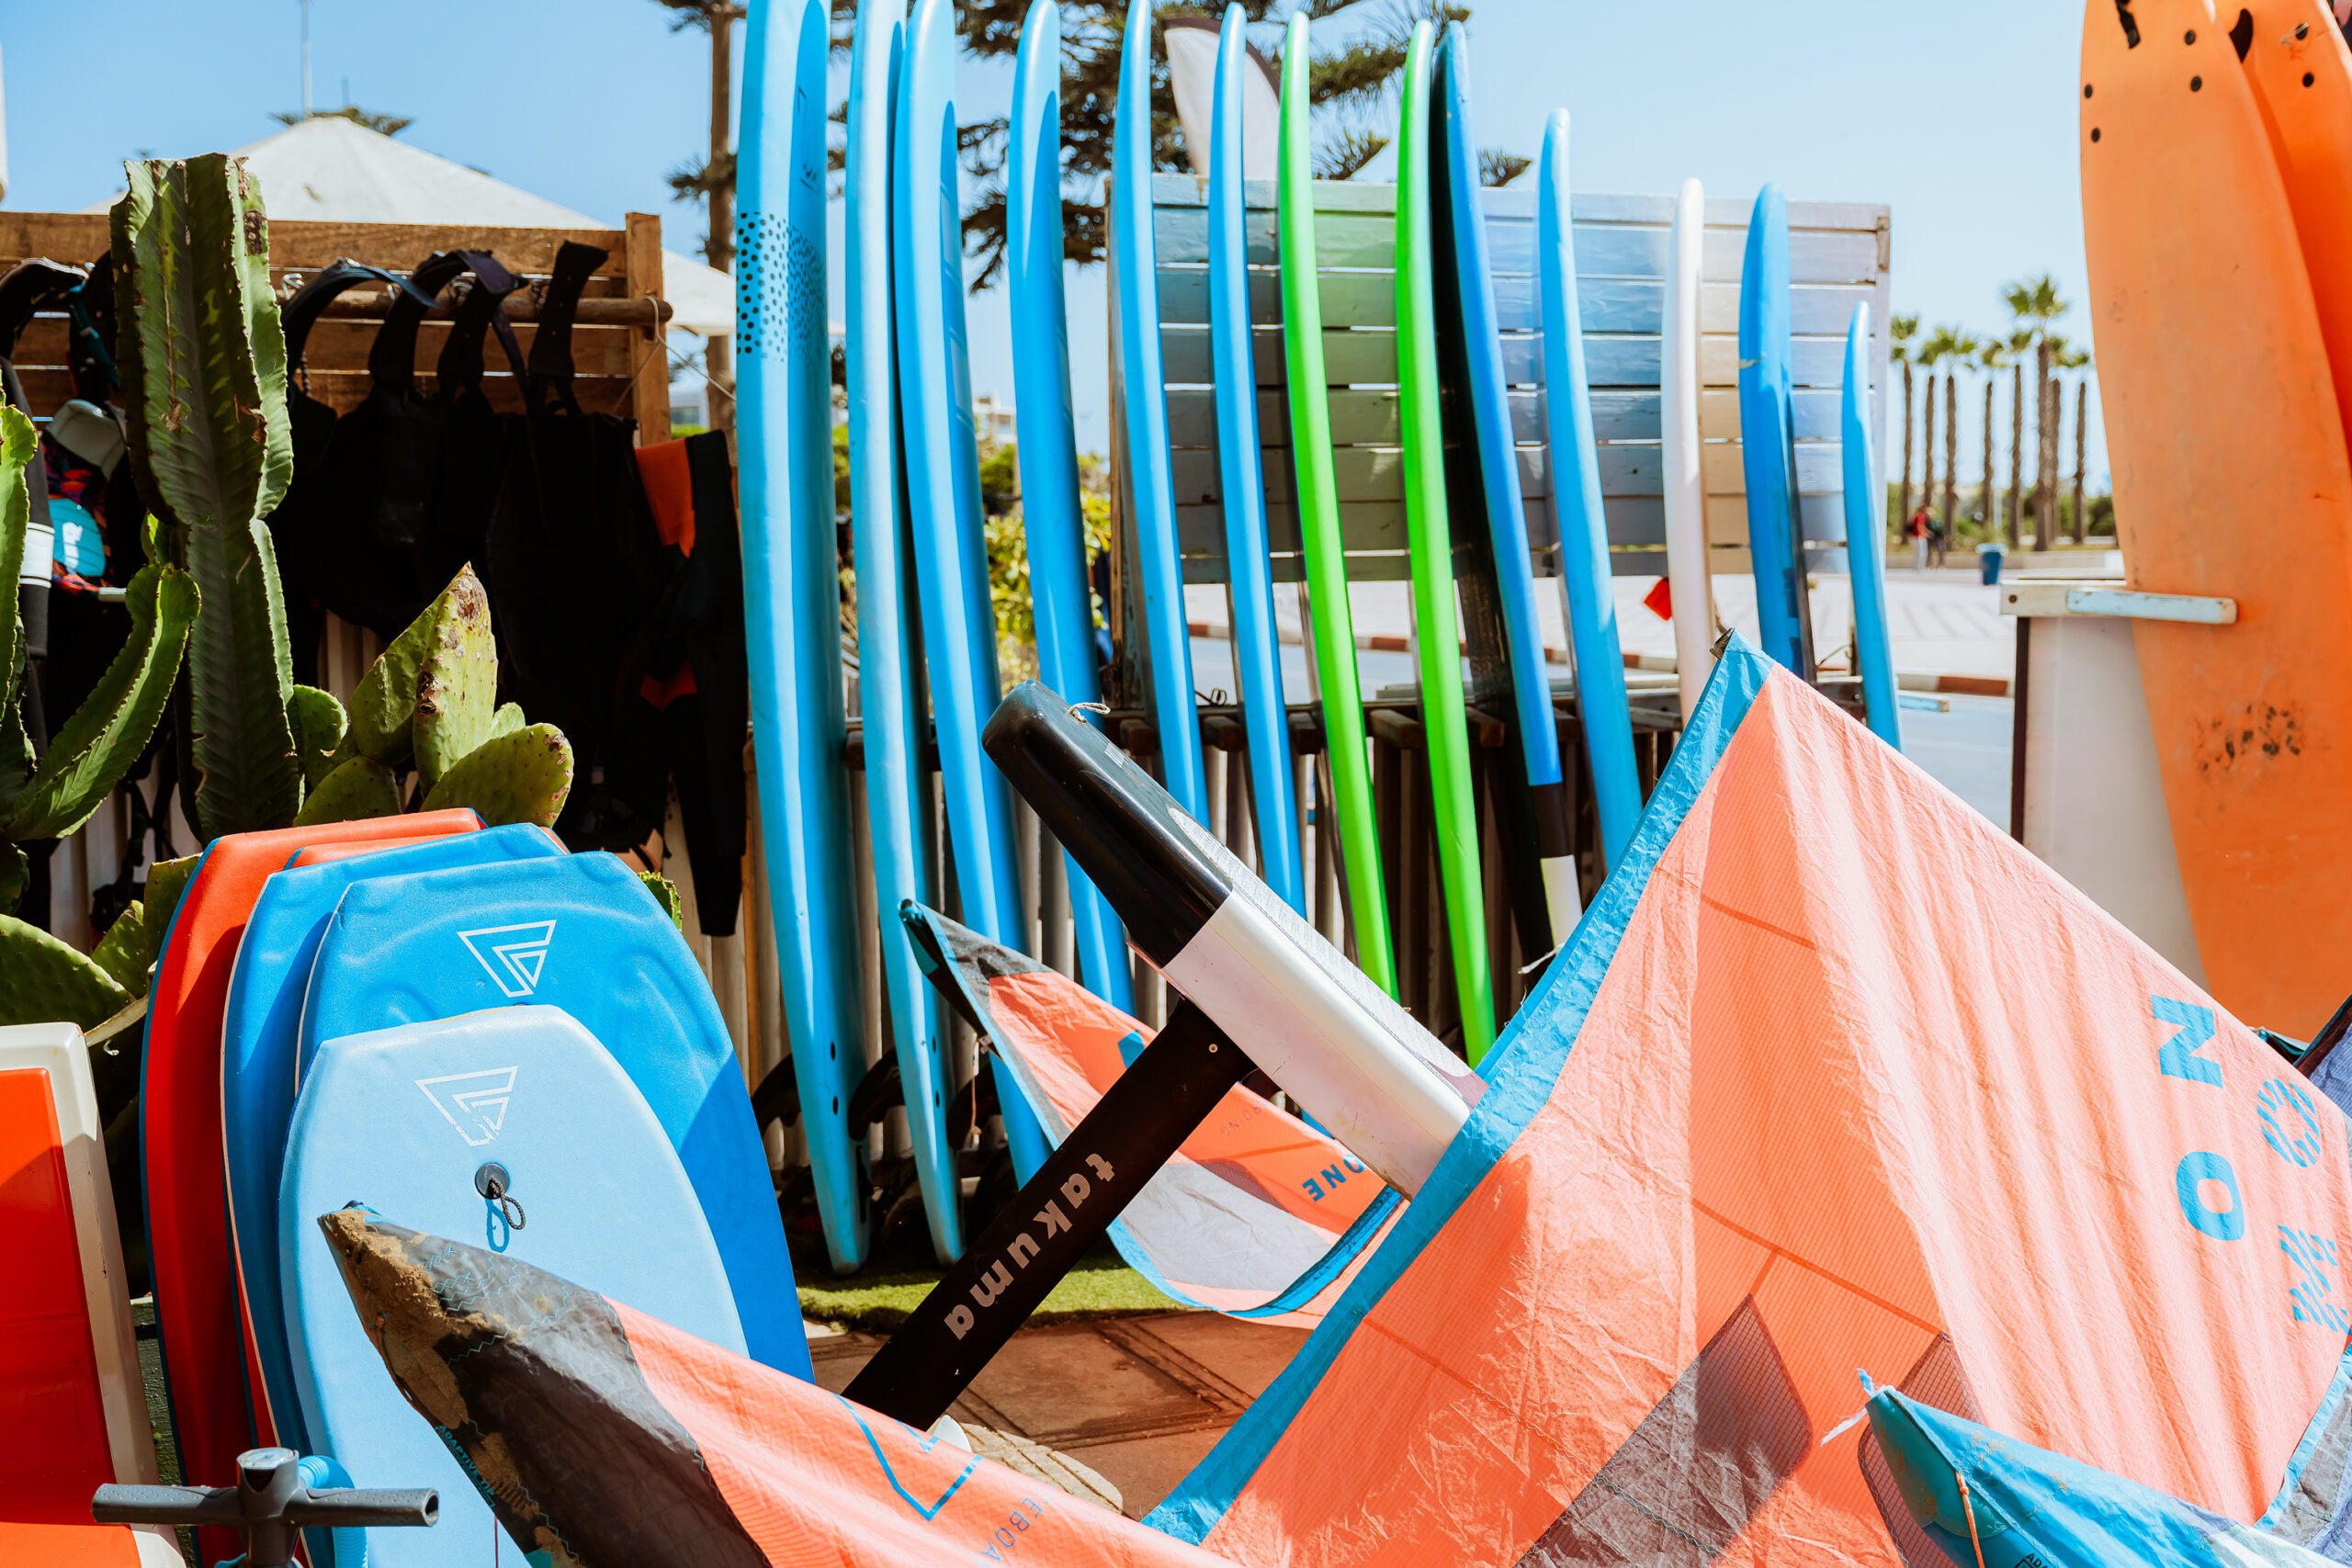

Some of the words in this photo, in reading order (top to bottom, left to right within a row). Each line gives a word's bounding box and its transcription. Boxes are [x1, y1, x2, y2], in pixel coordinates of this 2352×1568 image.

[1301, 1154, 1365, 1202] ONE
[944, 1153, 1115, 1340] takuma
[438, 1425, 481, 1478] ADAPTIVE
[481, 1479, 495, 1496] TIP
